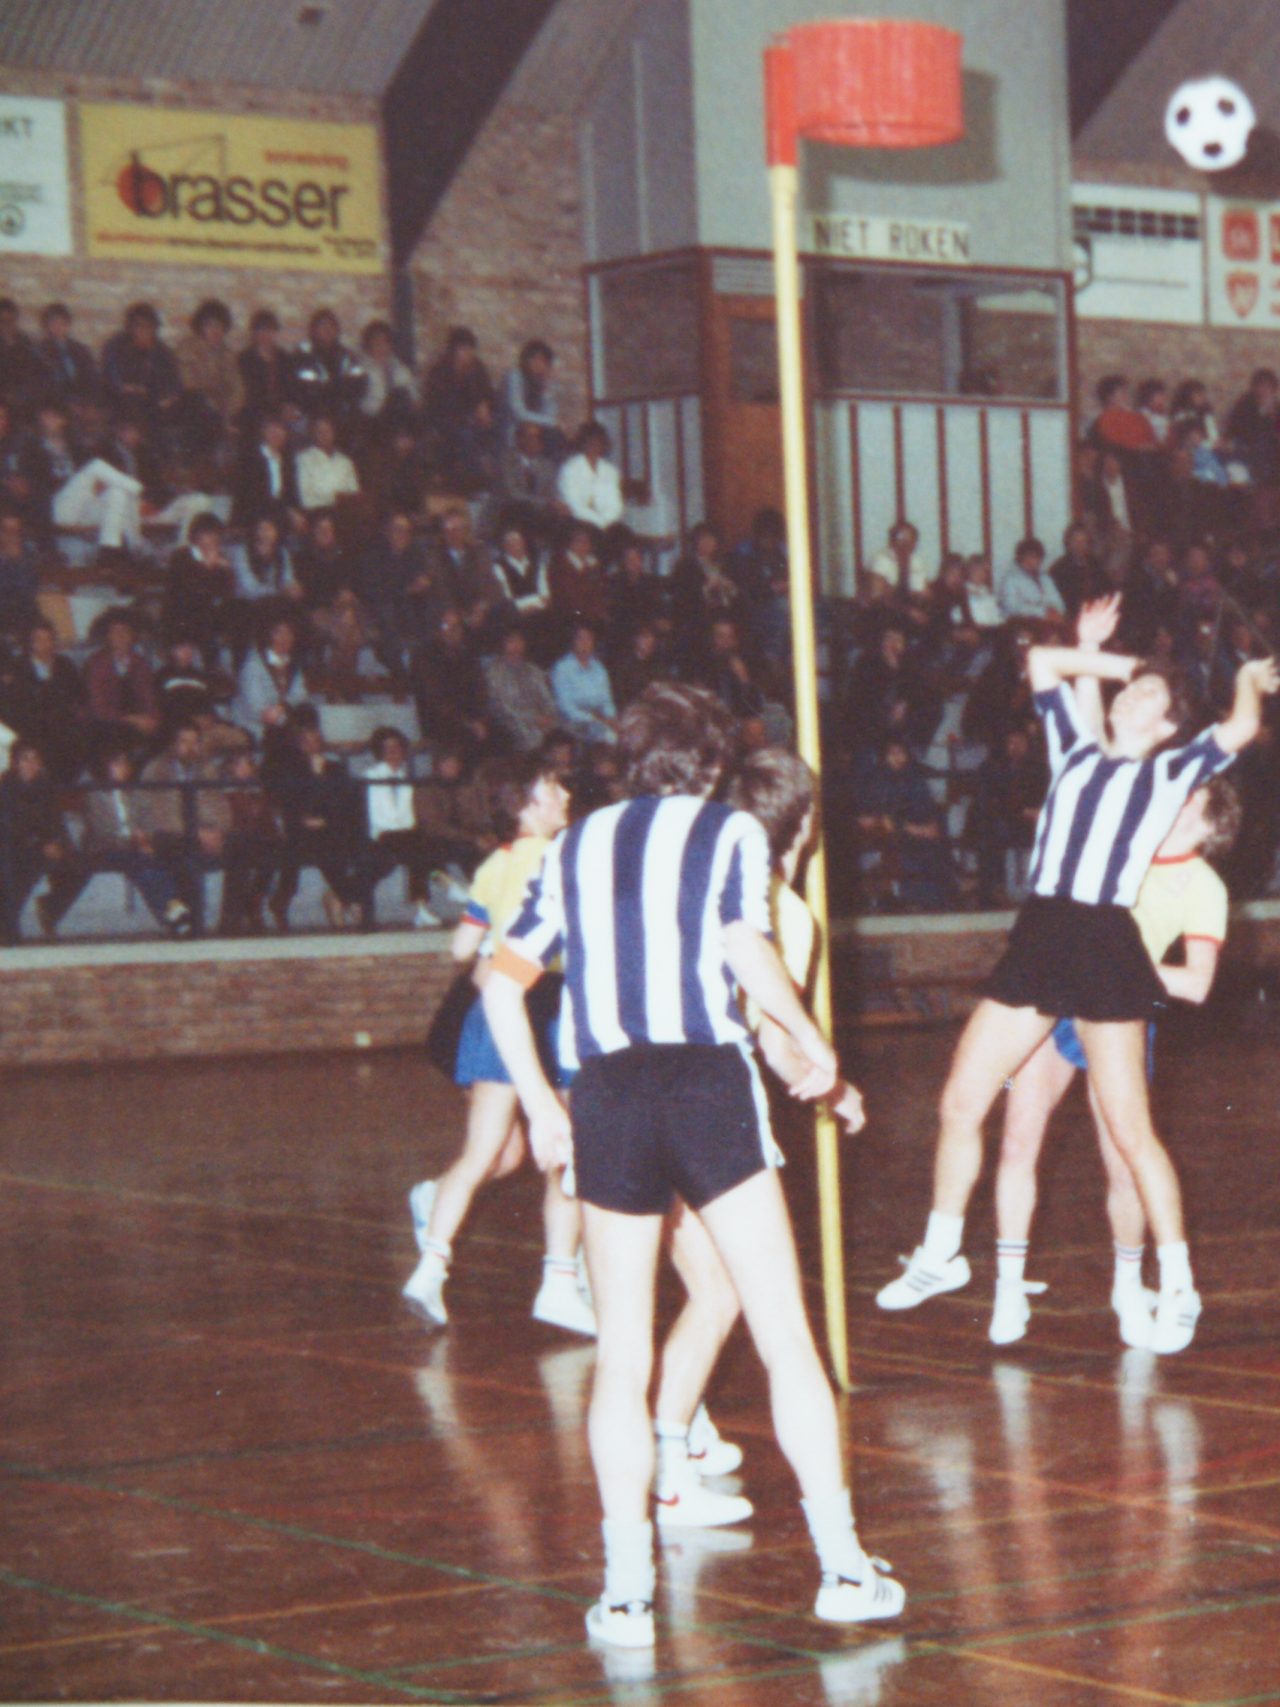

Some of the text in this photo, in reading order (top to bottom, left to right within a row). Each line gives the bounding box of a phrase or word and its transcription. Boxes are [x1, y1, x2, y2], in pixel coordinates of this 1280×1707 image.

[128, 150, 349, 231] brasser
[813, 218, 970, 258] NIET ROKEN
